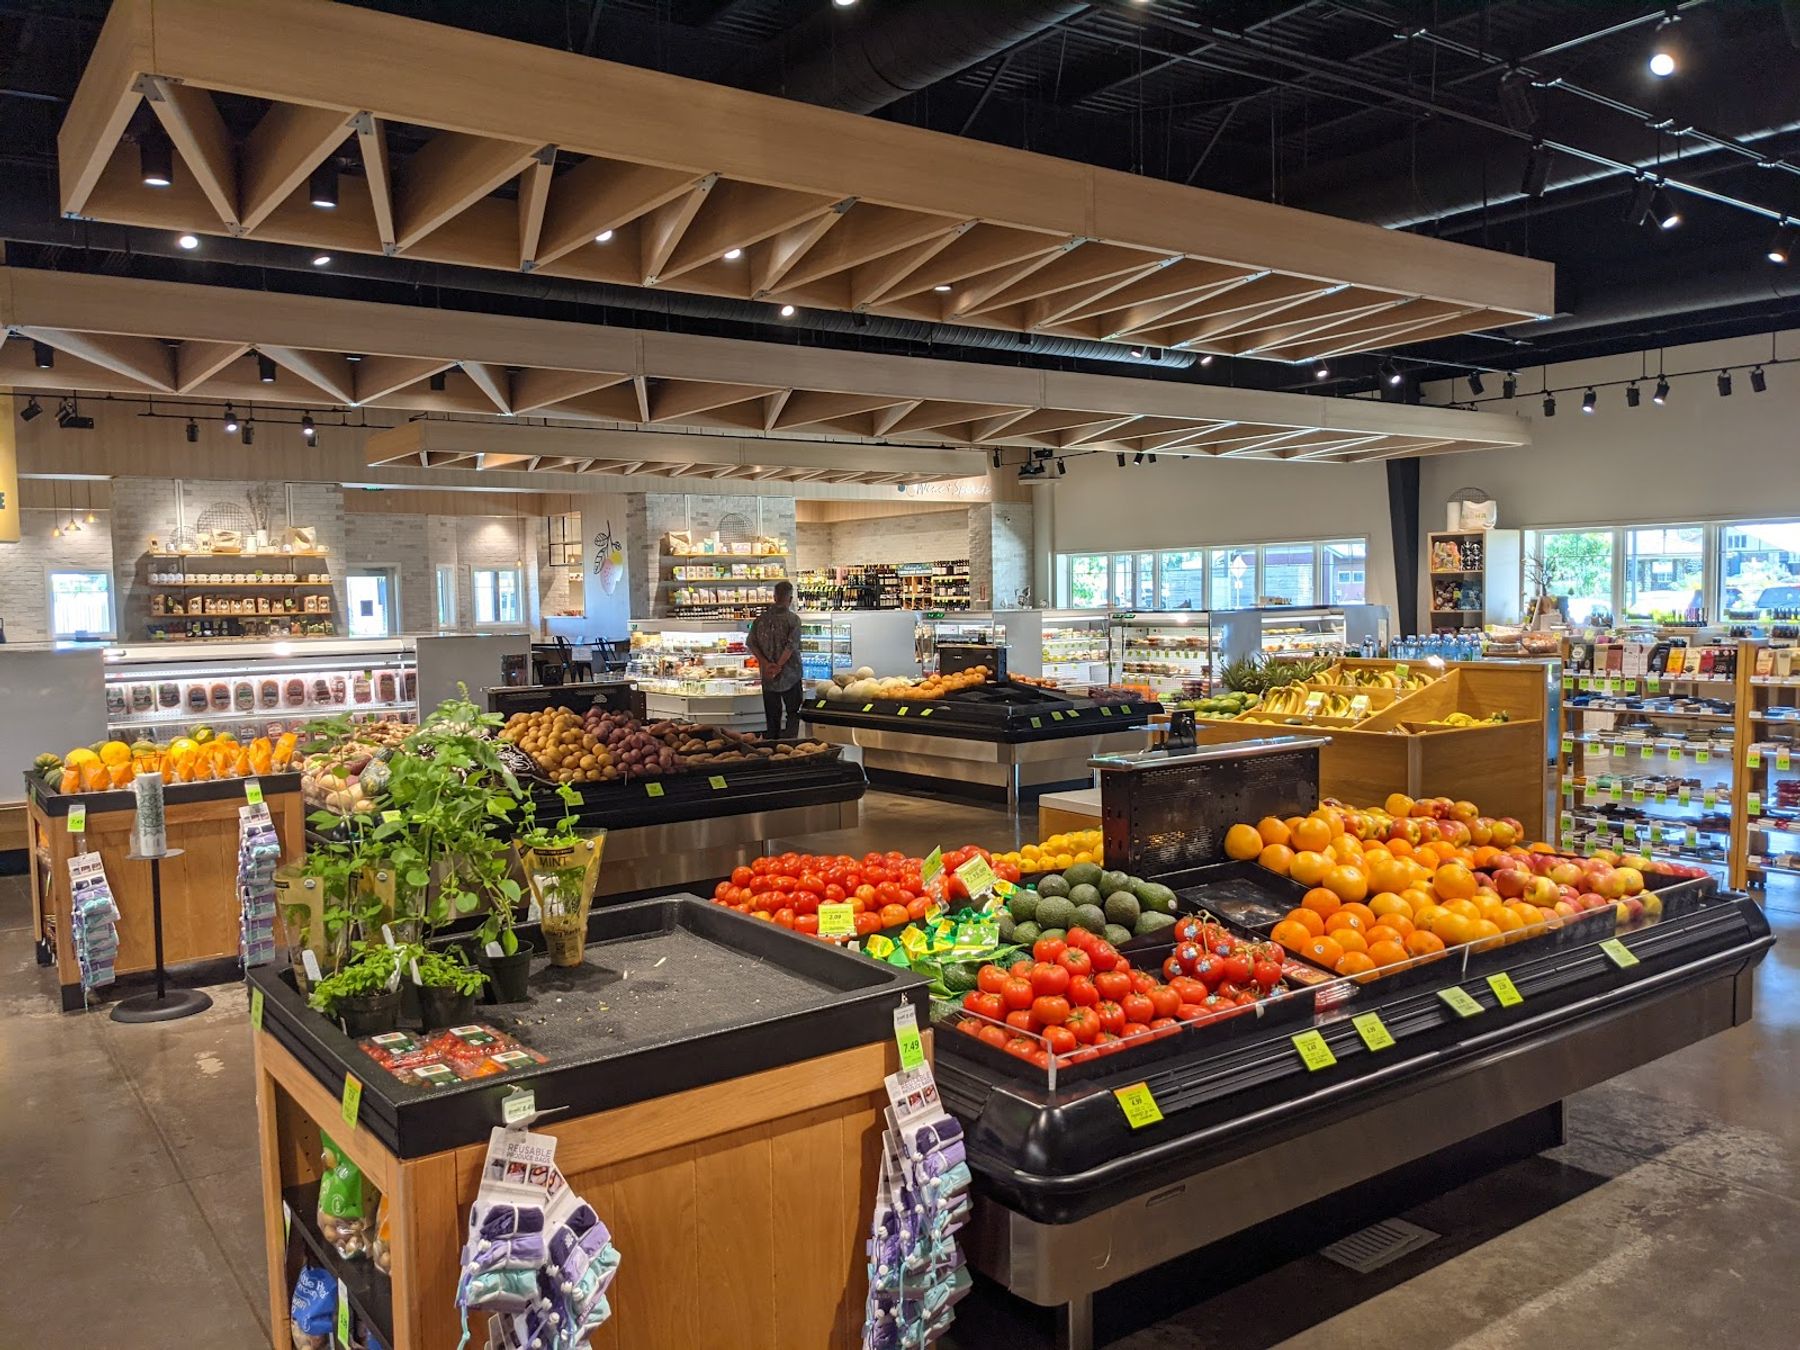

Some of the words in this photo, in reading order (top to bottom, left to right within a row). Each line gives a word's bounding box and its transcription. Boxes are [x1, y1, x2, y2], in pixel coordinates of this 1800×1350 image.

[540, 856, 567, 867] MINT
[903, 1039, 920, 1054] 7.49
[507, 1143, 553, 1158] REUSABLE
